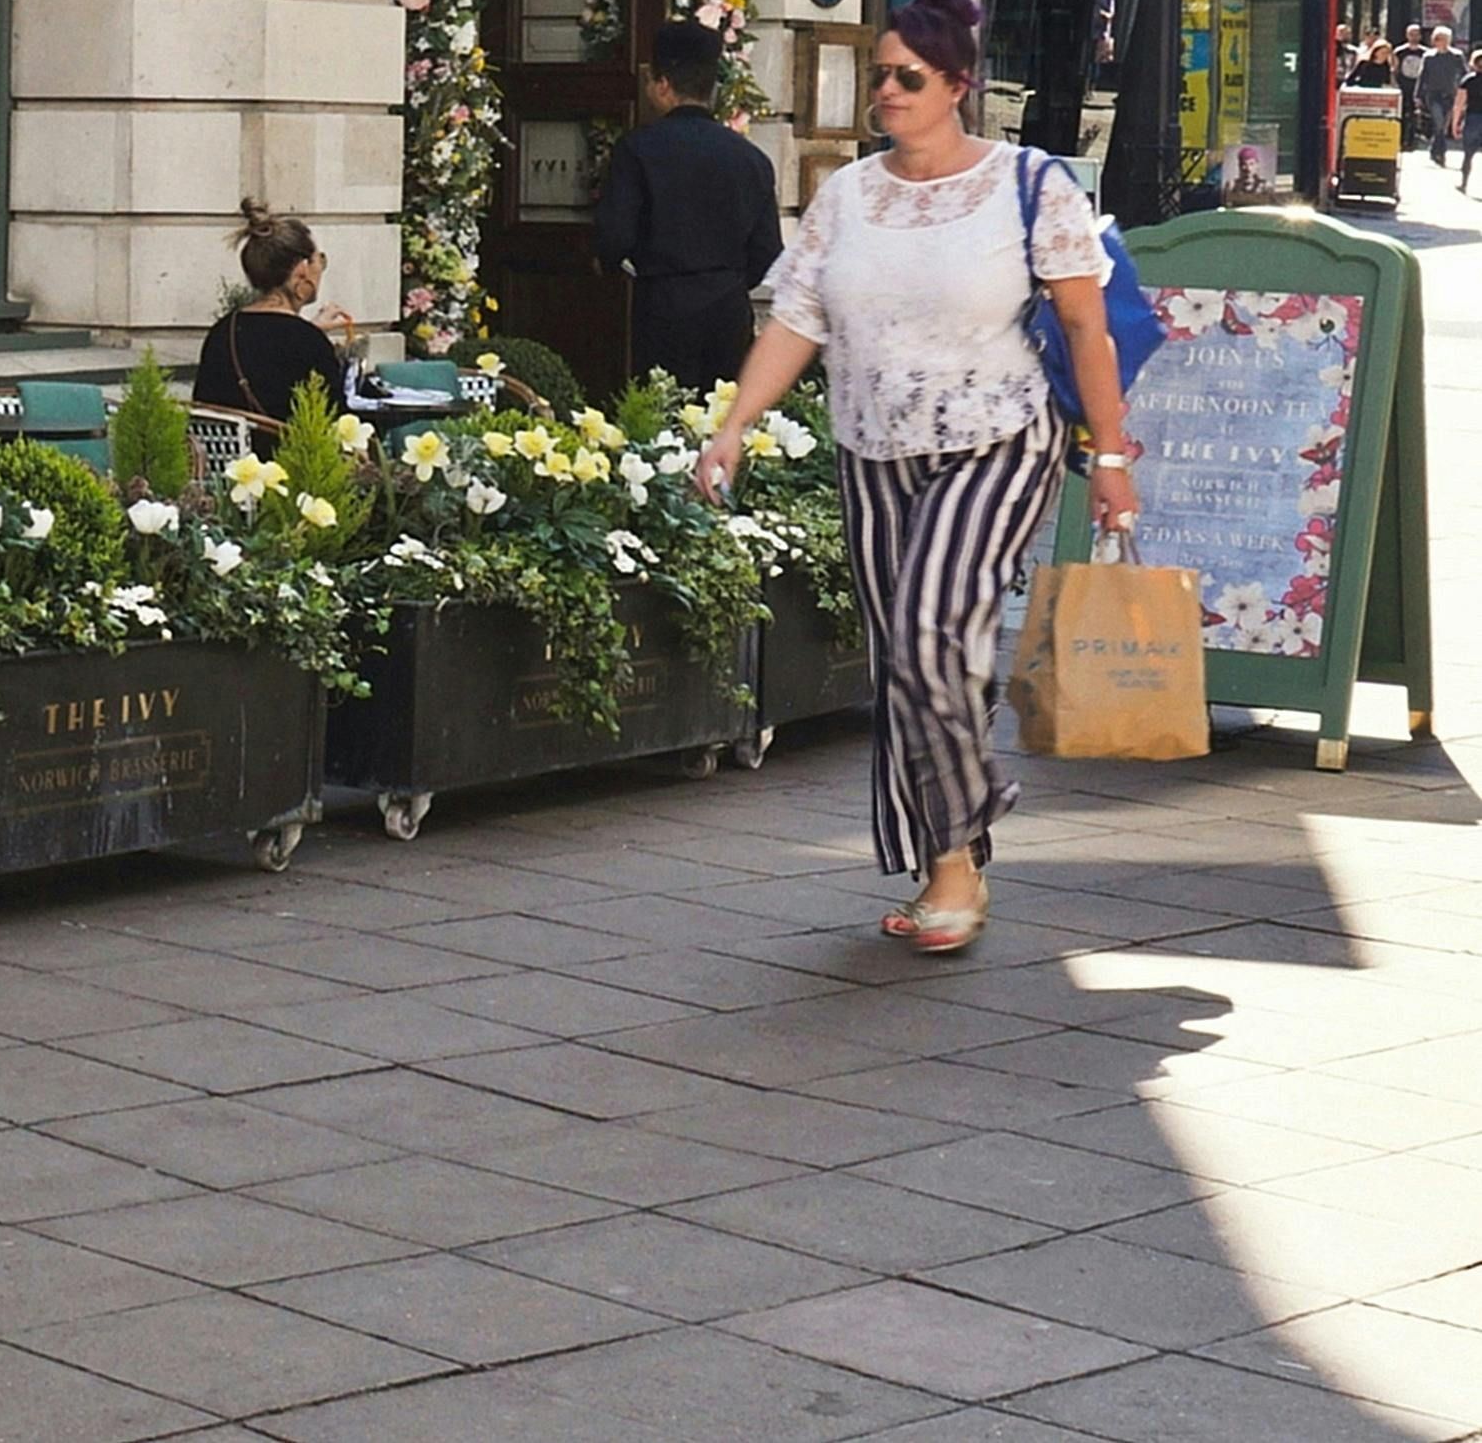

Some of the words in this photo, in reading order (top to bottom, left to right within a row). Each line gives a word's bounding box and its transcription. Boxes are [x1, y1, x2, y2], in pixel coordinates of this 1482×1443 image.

[1183, 346, 1243, 368] JOIN
[1254, 349, 1285, 369] US
[1135, 392, 1274, 417] AFTERNOON
[1162, 440, 1215, 461] THE
[1229, 442, 1287, 464] IVY
[1230, 533, 1285, 552] WEEK
[44, 698, 107, 735] THE
[120, 687, 180, 724] IVY
[18, 763, 101, 794] NORWICH
[108, 748, 199, 783] BRASSERIE
